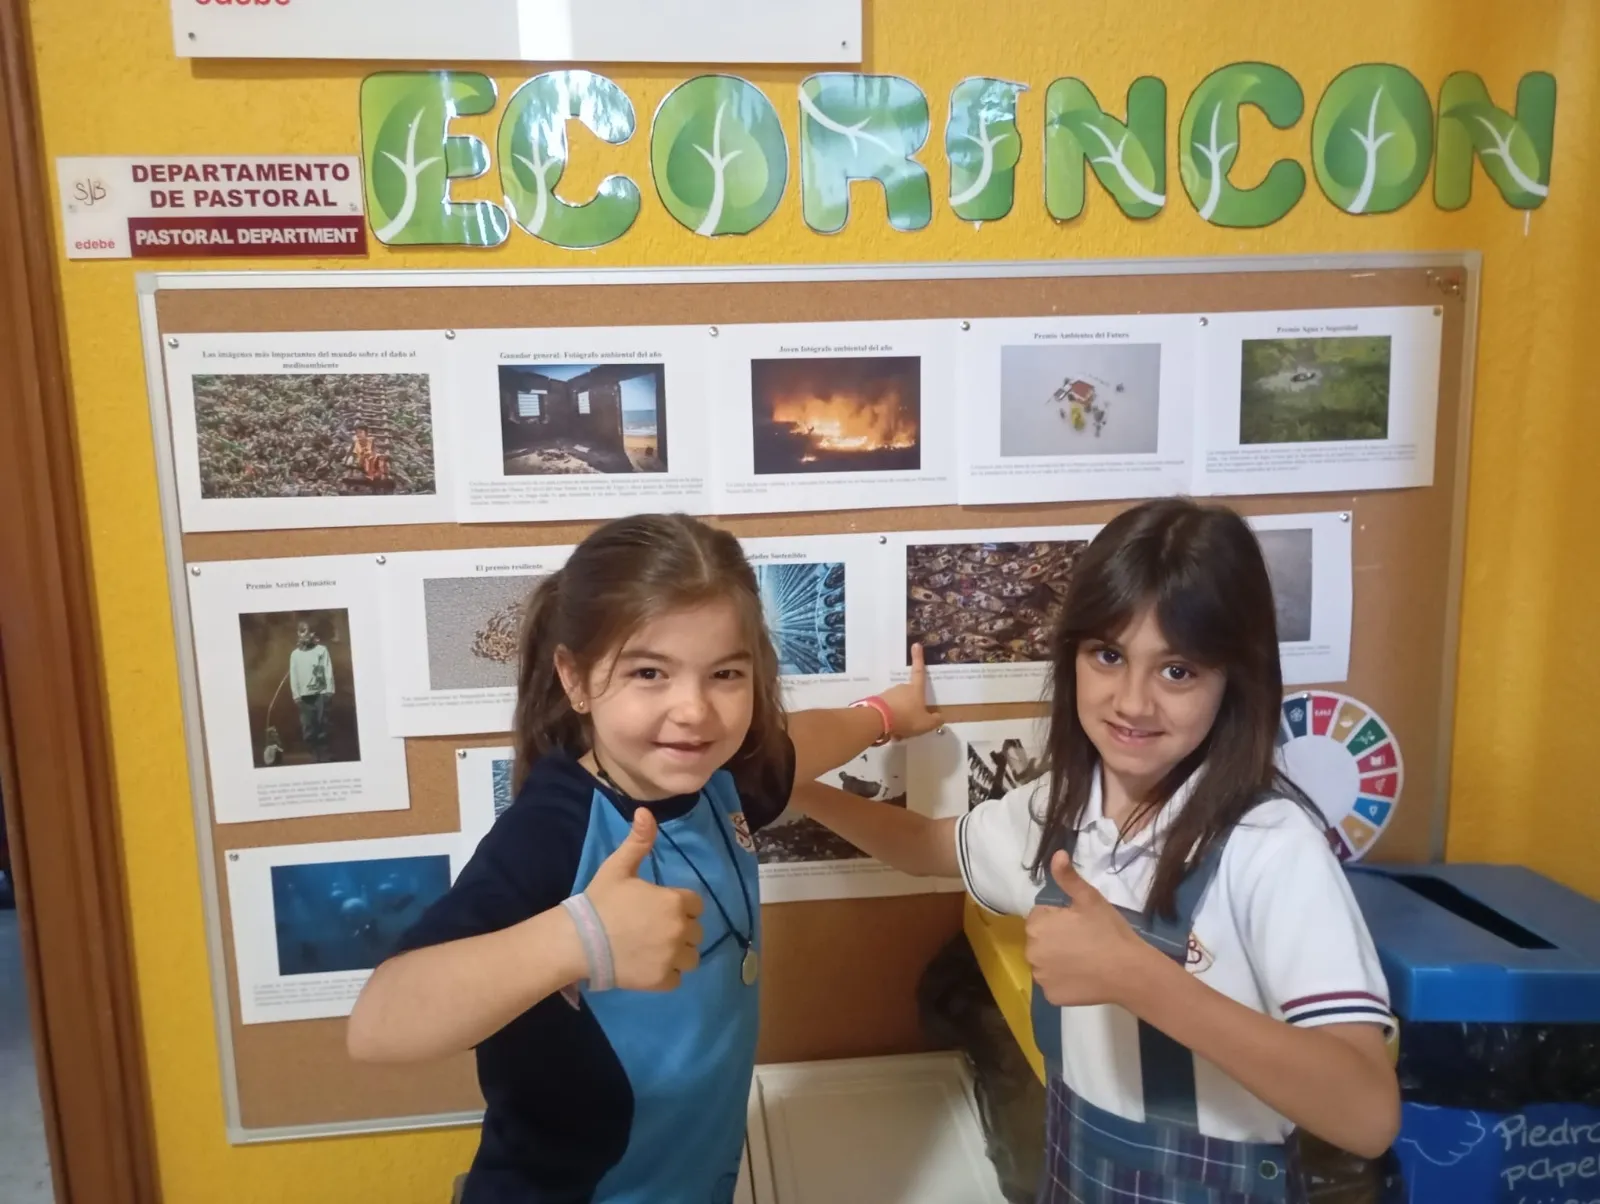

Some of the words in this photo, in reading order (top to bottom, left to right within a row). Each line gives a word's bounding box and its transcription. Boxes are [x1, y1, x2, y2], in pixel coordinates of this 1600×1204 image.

[132, 163, 350, 183] DEPARTAMENTO
[150, 190, 185, 209] DE
[194, 188, 338, 208] PASTORAL
[135, 229, 235, 246] PASTORAL
[237, 228, 358, 245] DEPARTMENT
[202, 350, 216, 358] Las
[331, 350, 357, 358] mundo
